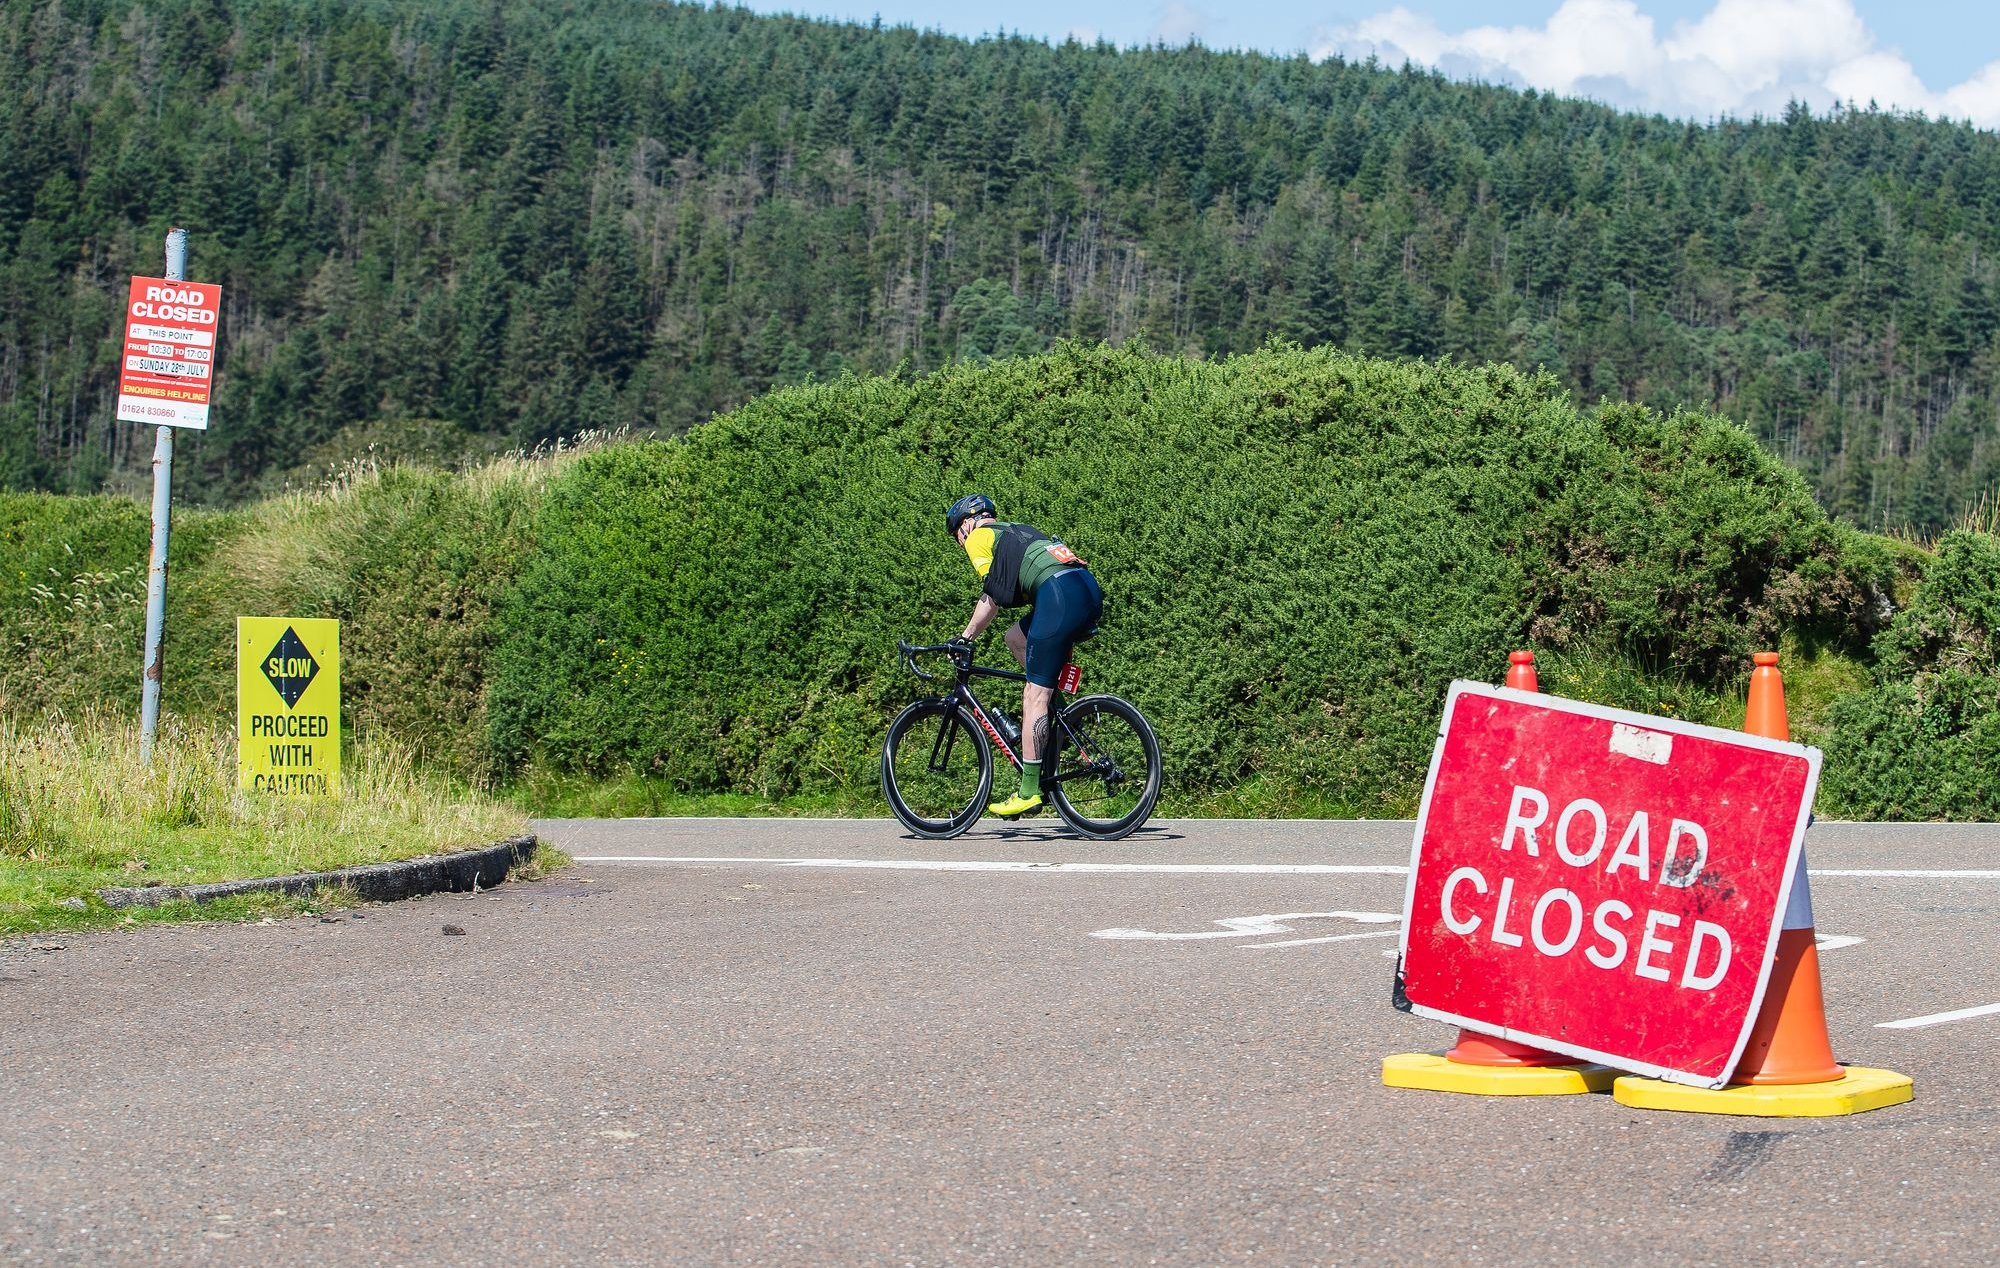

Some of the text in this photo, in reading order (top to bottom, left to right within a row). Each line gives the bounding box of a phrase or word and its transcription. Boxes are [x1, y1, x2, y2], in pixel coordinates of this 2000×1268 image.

[146, 286, 204, 306] ROAD
[132, 302, 216, 324] CLOSED
[148, 329, 167, 338] THIS
[168, 332, 194, 340] POINT
[128, 343, 208, 360] FROM 10:30 TO 17:00
[139, 359, 170, 371] SUNDAY
[186, 365, 206, 376] JULY
[124, 385, 207, 401] ENQUIRIES HELPLINE
[122, 404, 145, 414] 01624
[147, 407, 175, 418] 830860
[269, 657, 311, 678] SLOW
[1067, 666, 1077, 683] 1211
[252, 715, 329, 737] PROCEED
[270, 745, 313, 766] WITH
[1500, 785, 1708, 888] ROAD
[1440, 867, 1732, 991] CLOSED
